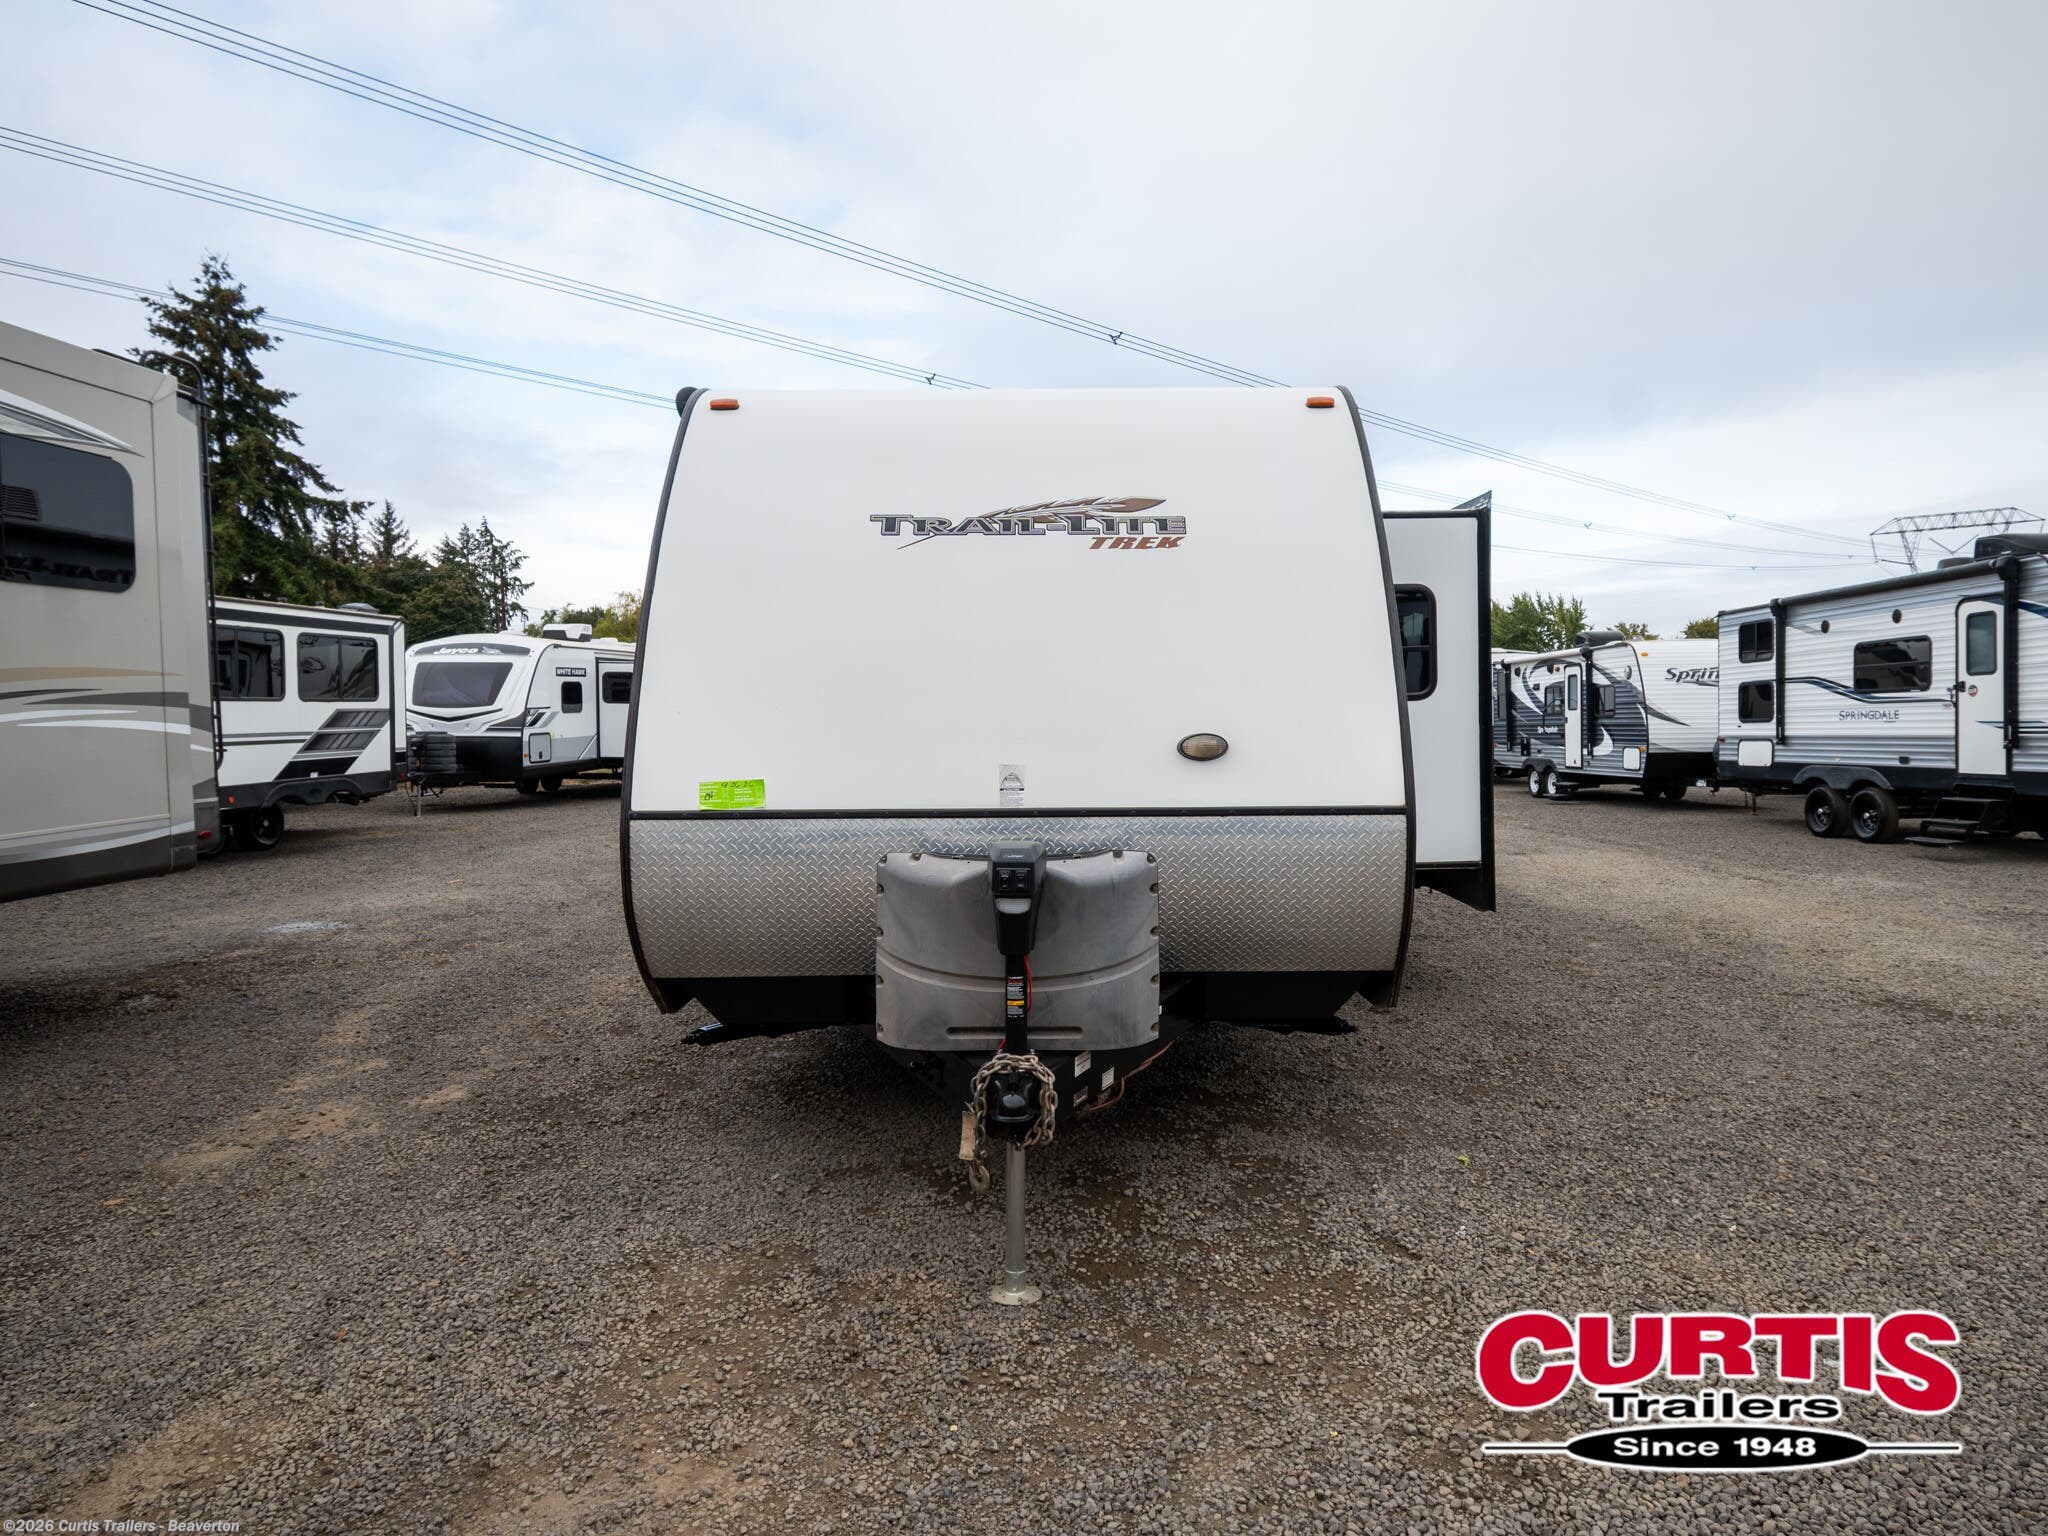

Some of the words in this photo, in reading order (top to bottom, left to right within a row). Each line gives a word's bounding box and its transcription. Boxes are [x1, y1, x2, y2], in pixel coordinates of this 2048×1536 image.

[869, 513, 1187, 537] TRAIL-LITE
[1088, 536, 1185, 550] TREK
[433, 647, 479, 655] Jayco
[556, 668, 571, 676] WHITE
[572, 668, 586, 676] HAWK
[1839, 709, 1900, 721] SPRINGDALE
